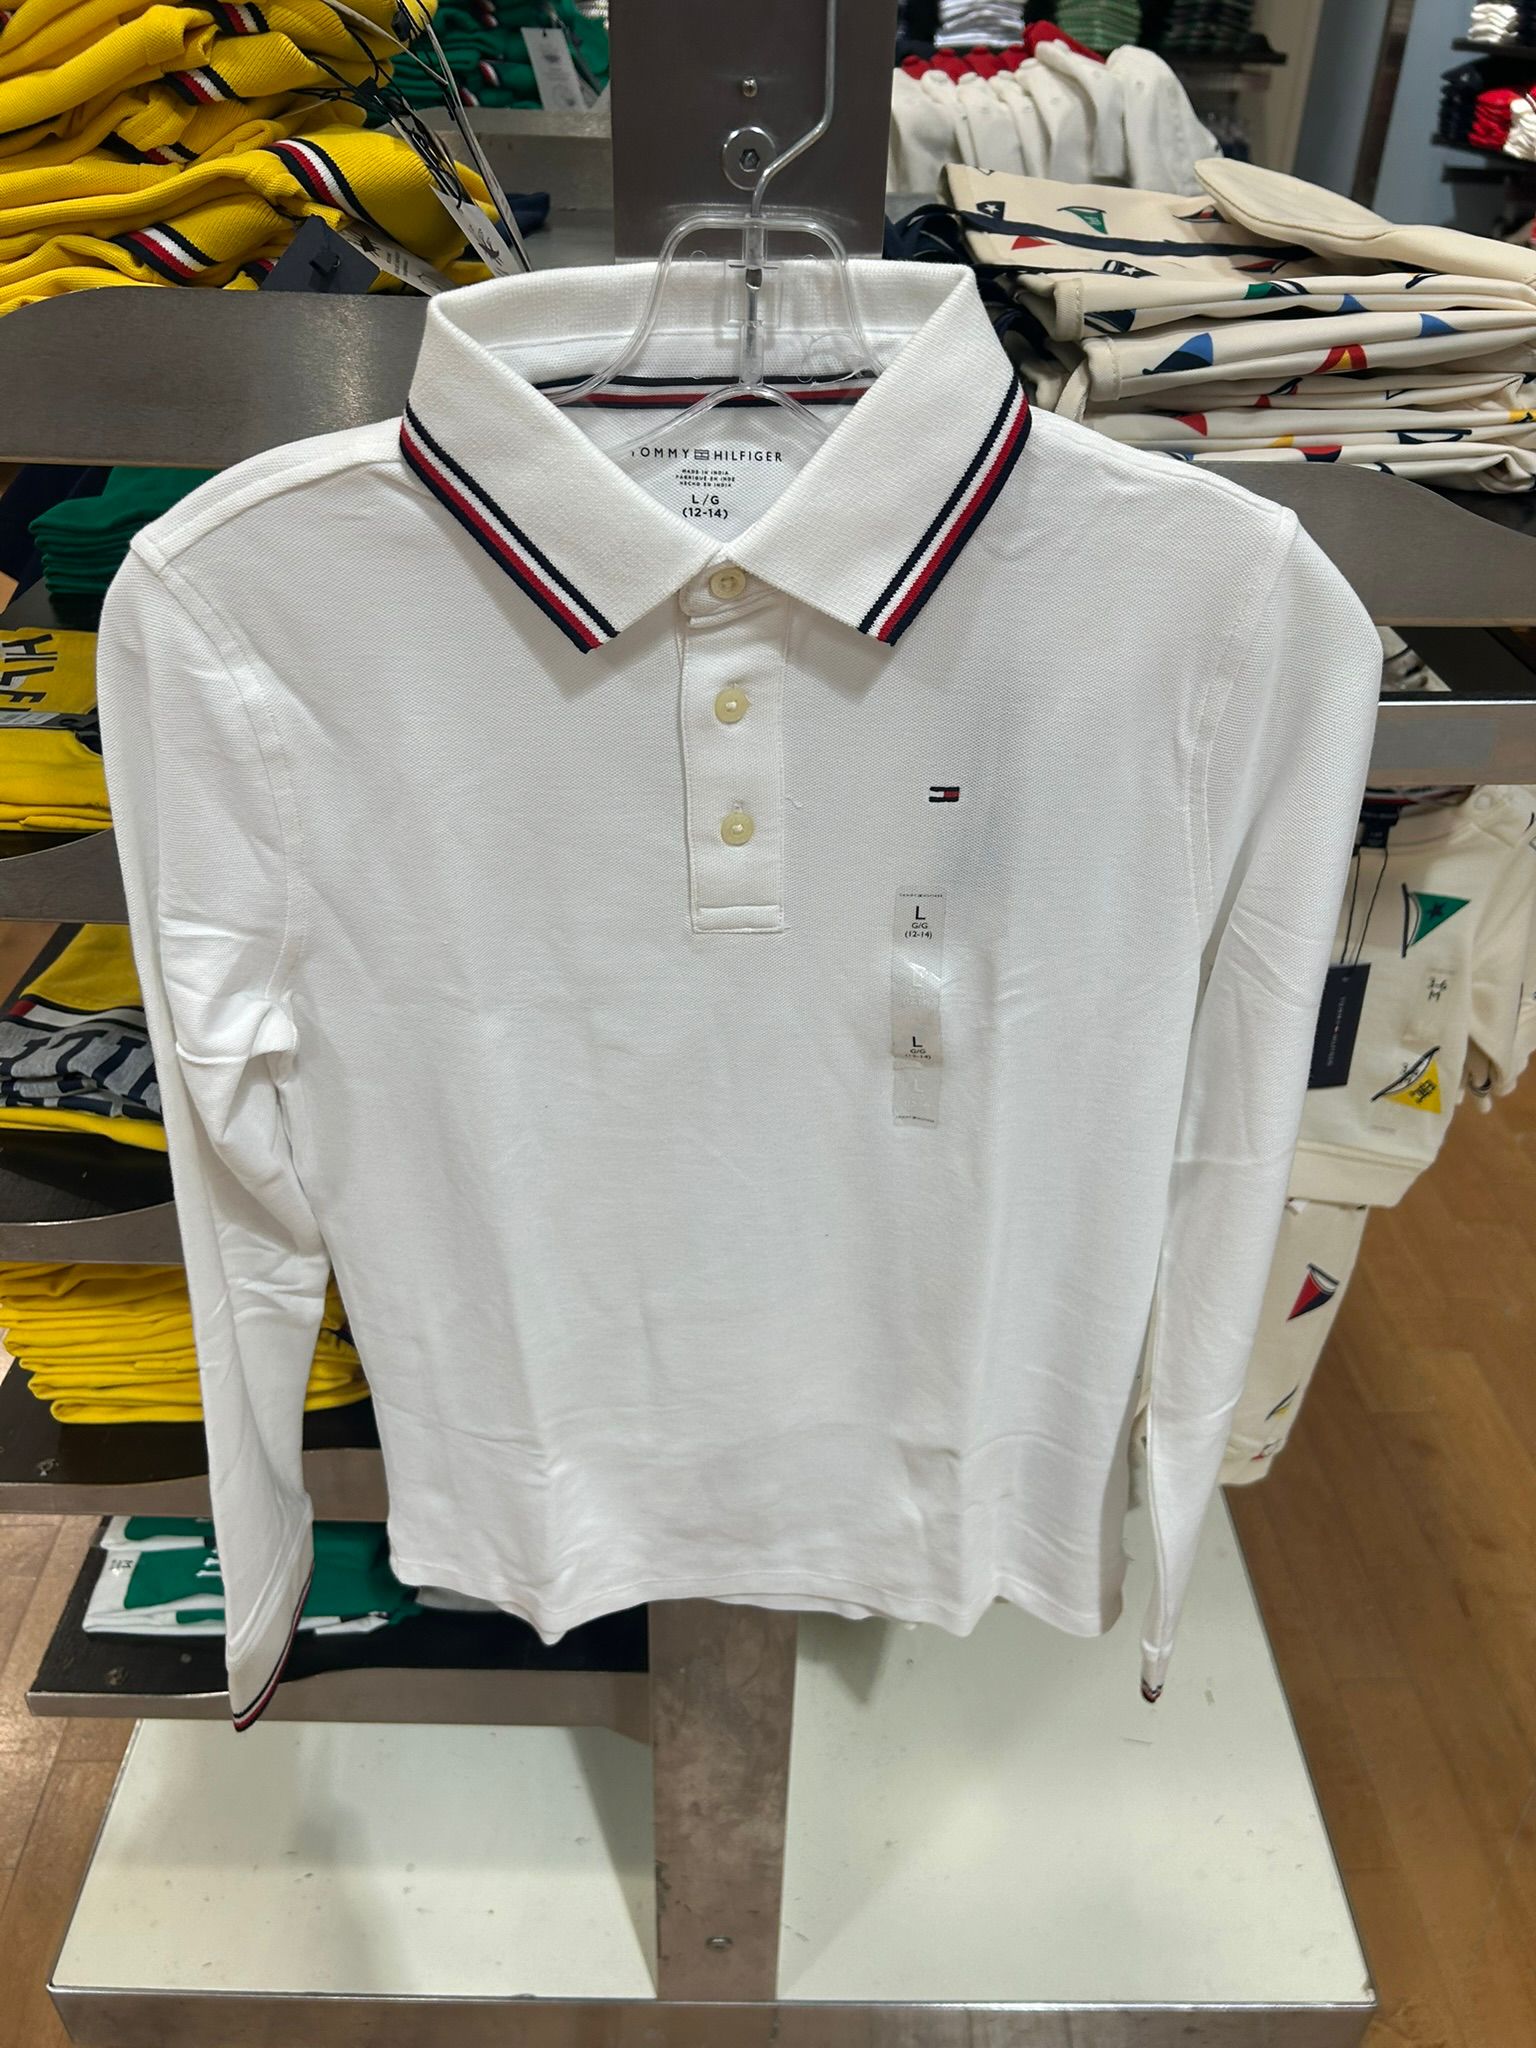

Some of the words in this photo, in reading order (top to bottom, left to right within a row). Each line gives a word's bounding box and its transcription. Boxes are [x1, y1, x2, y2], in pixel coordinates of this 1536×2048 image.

[714, 451, 782, 462] HILFIGER
[692, 494, 720, 506] L/G
[682, 507, 728, 520] (12-14)
[915, 905, 926, 920] L
[911, 922, 929, 930] G/G
[904, 930, 933, 940] (12-14)
[912, 1036, 924, 1048] L
